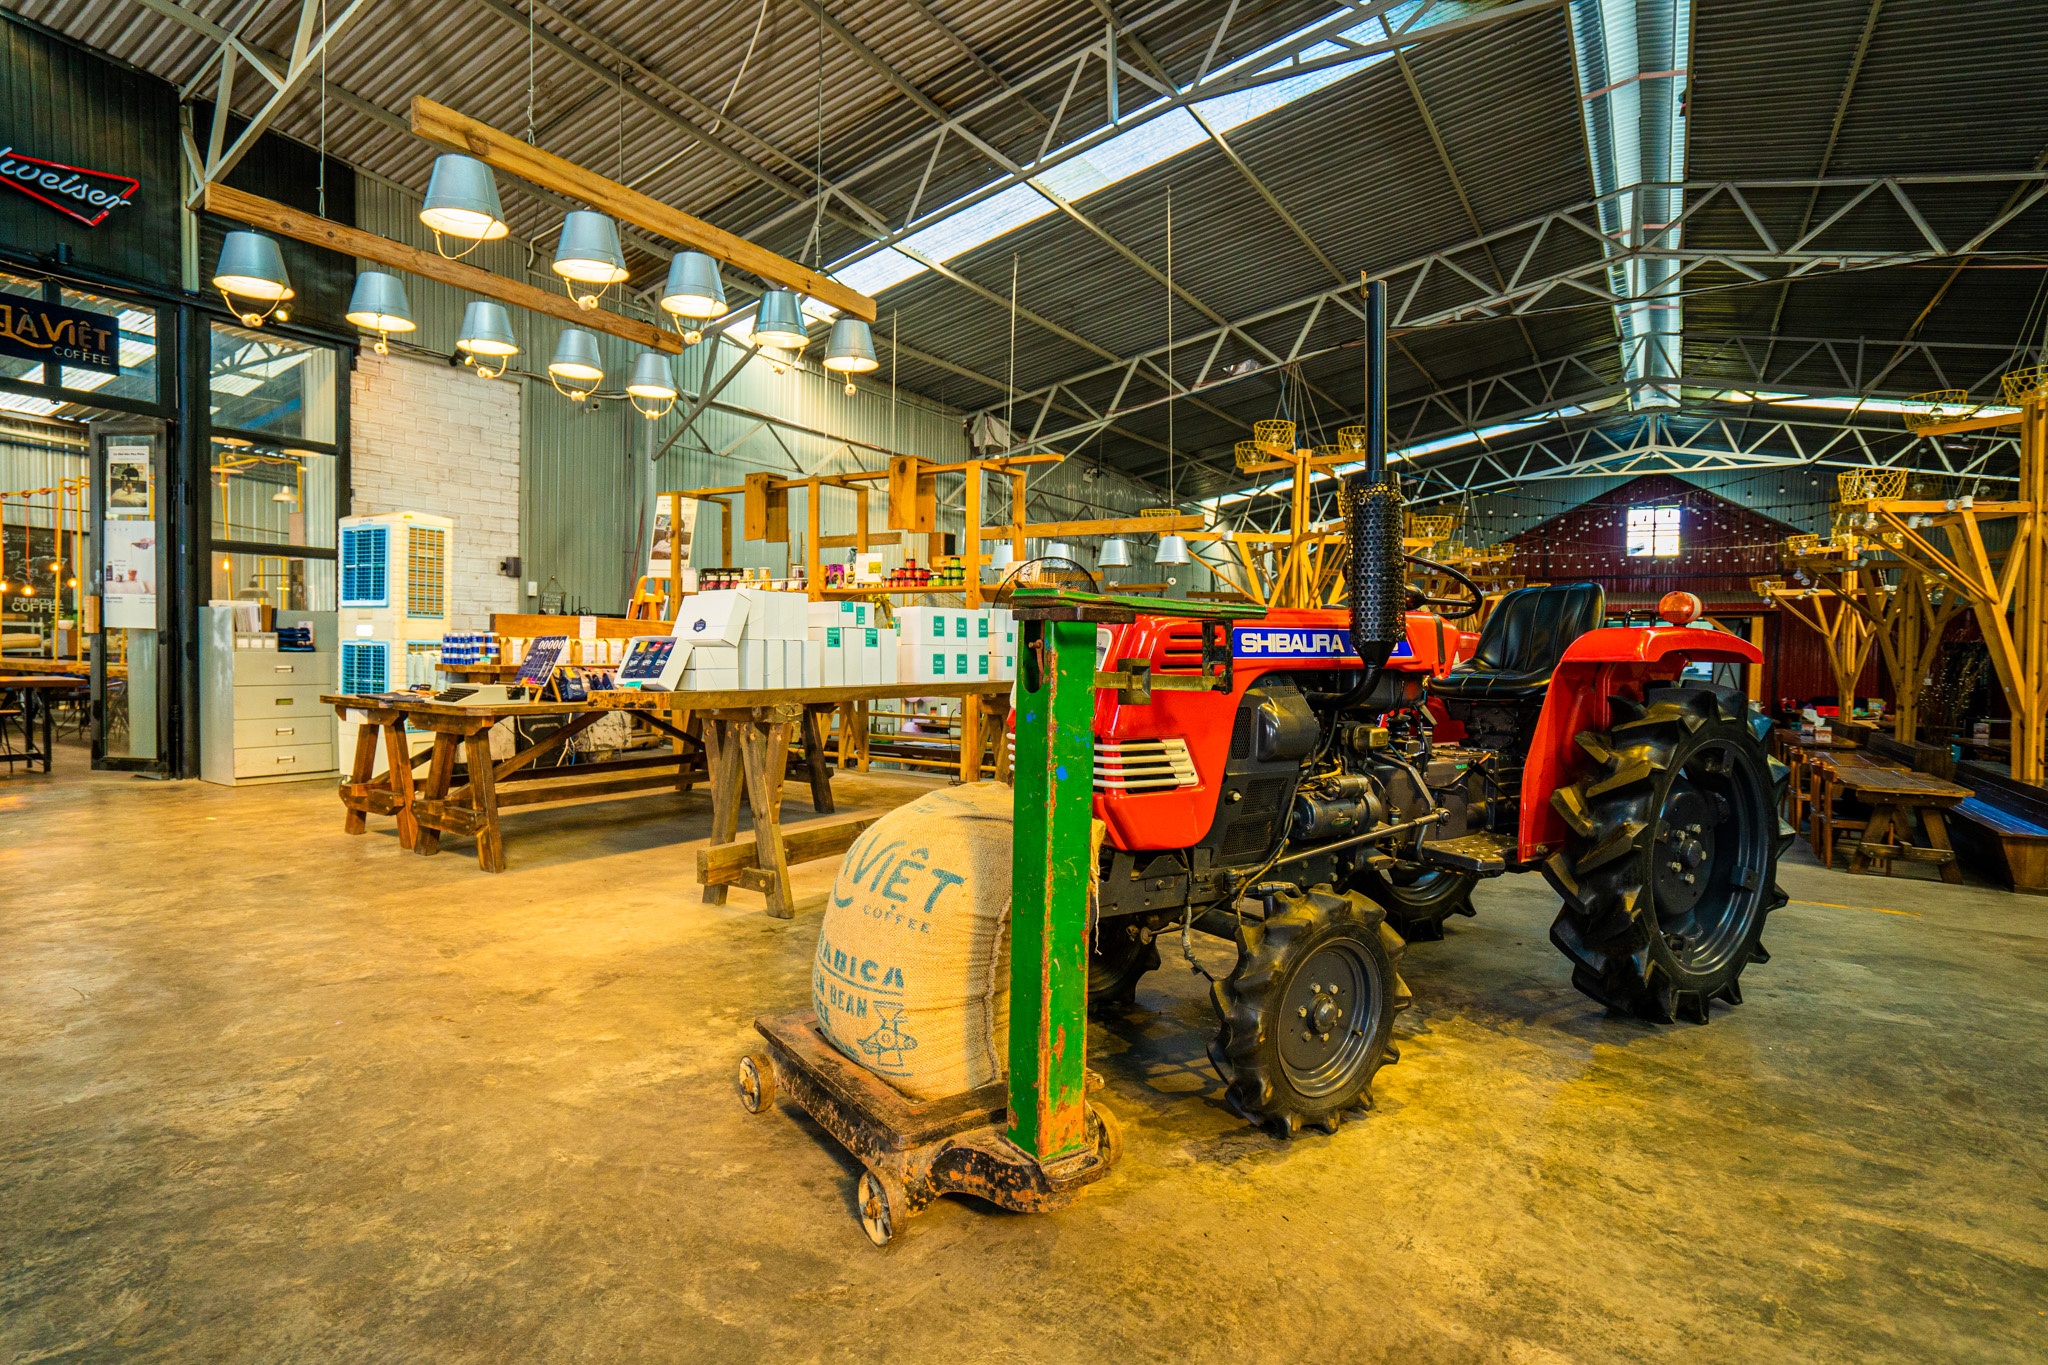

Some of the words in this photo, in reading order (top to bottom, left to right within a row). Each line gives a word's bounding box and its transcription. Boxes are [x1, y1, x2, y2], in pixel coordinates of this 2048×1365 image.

[0, 146, 132, 209] weiser
[40, 313, 112, 352] VIỆT
[53, 346, 111, 366] COFFEE
[1241, 633, 1345, 653] SHIBAURA
[863, 903, 931, 934] COFFEE
[829, 983, 868, 1019] BEAN
